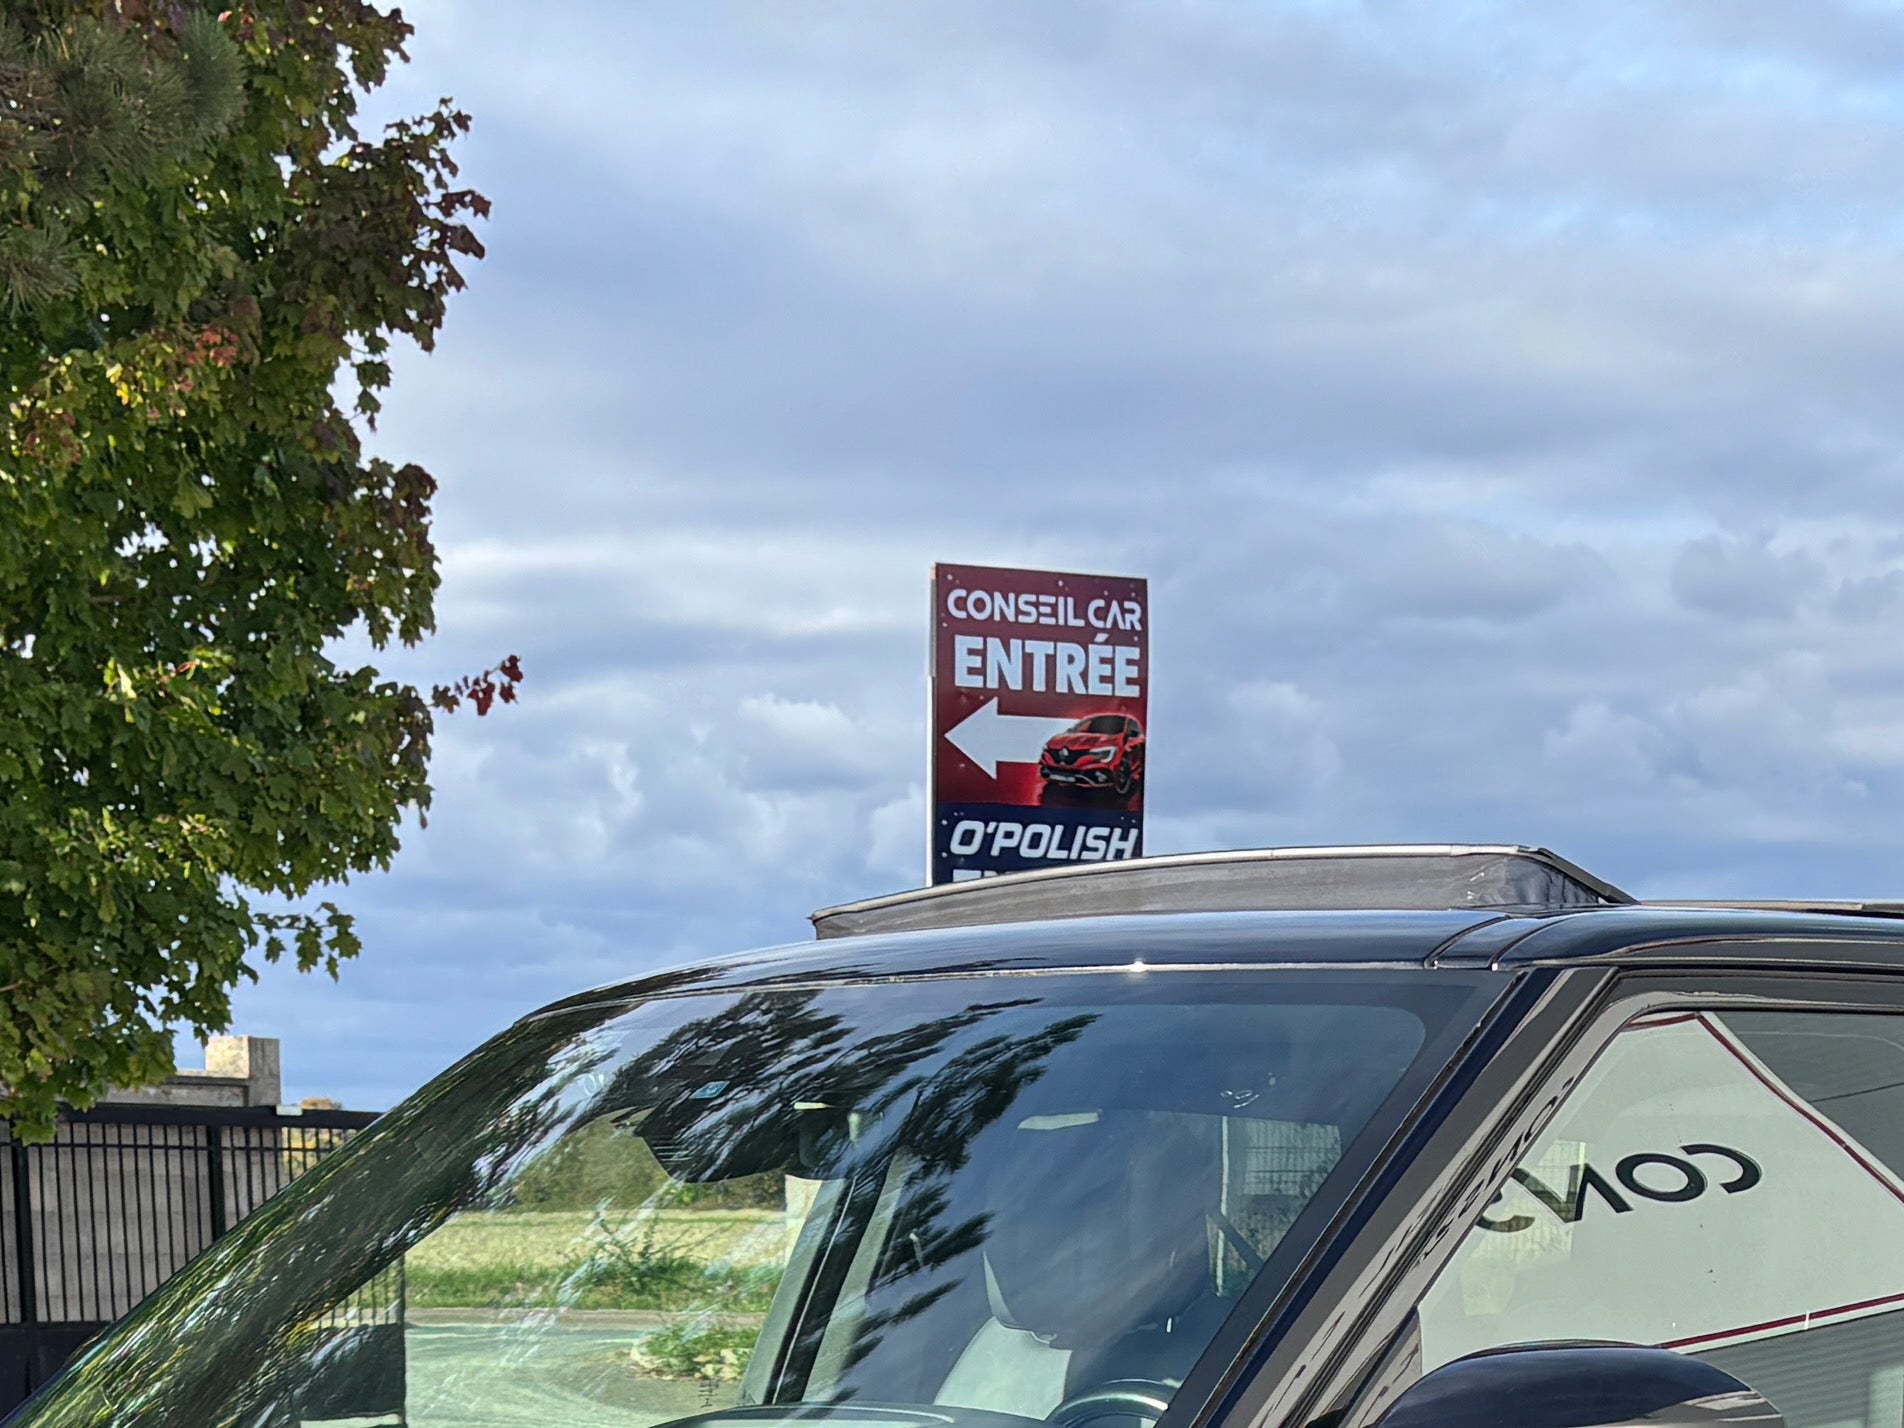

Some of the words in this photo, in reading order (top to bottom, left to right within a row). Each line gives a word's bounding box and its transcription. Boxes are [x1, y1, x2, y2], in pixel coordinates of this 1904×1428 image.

[947, 589, 1085, 627] CONSEIL
[1088, 599, 1141, 631] CAR
[955, 633, 1141, 698] ENTRÉE
[950, 820, 1138, 860] O'POLISH
